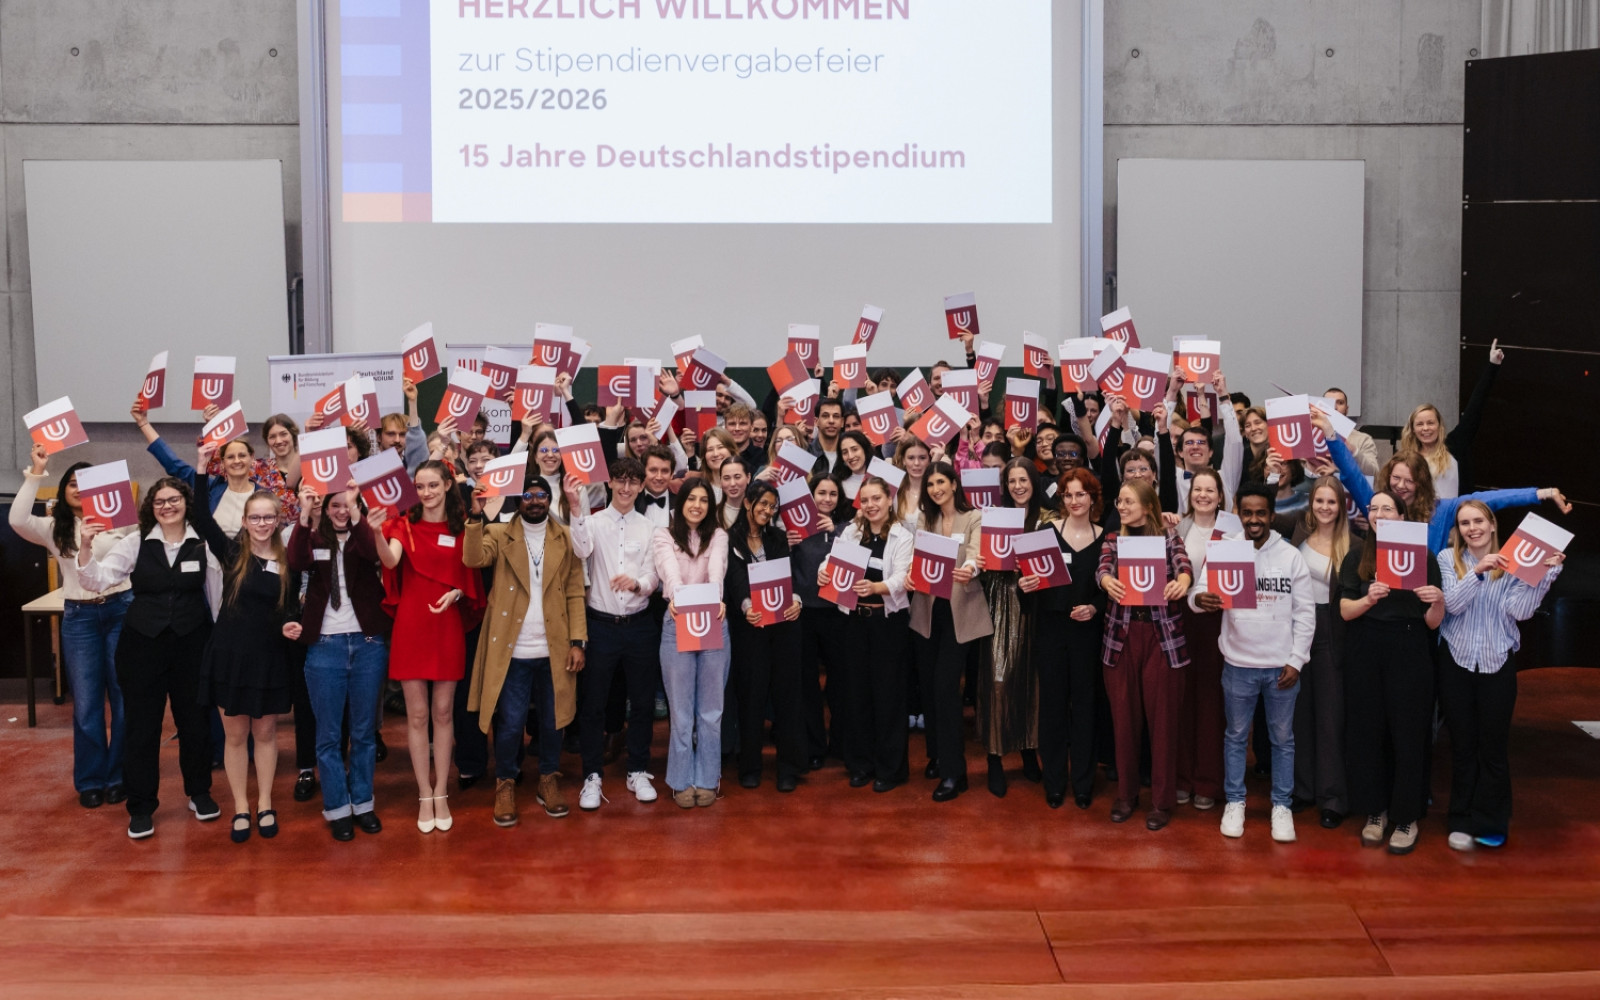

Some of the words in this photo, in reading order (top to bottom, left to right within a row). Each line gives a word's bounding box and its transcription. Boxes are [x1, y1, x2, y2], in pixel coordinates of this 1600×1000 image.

[458, 0, 641, 19] HERZLICH
[654, 0, 911, 20] WILLKOMMEN
[458, 51, 505, 73] zur
[514, 46, 885, 79] Stipendienvergabefeier
[458, 87, 608, 111] 2025/2026
[458, 144, 489, 169] 15
[500, 142, 587, 169] Jahre
[597, 142, 966, 174] Deutschlandstipendium
